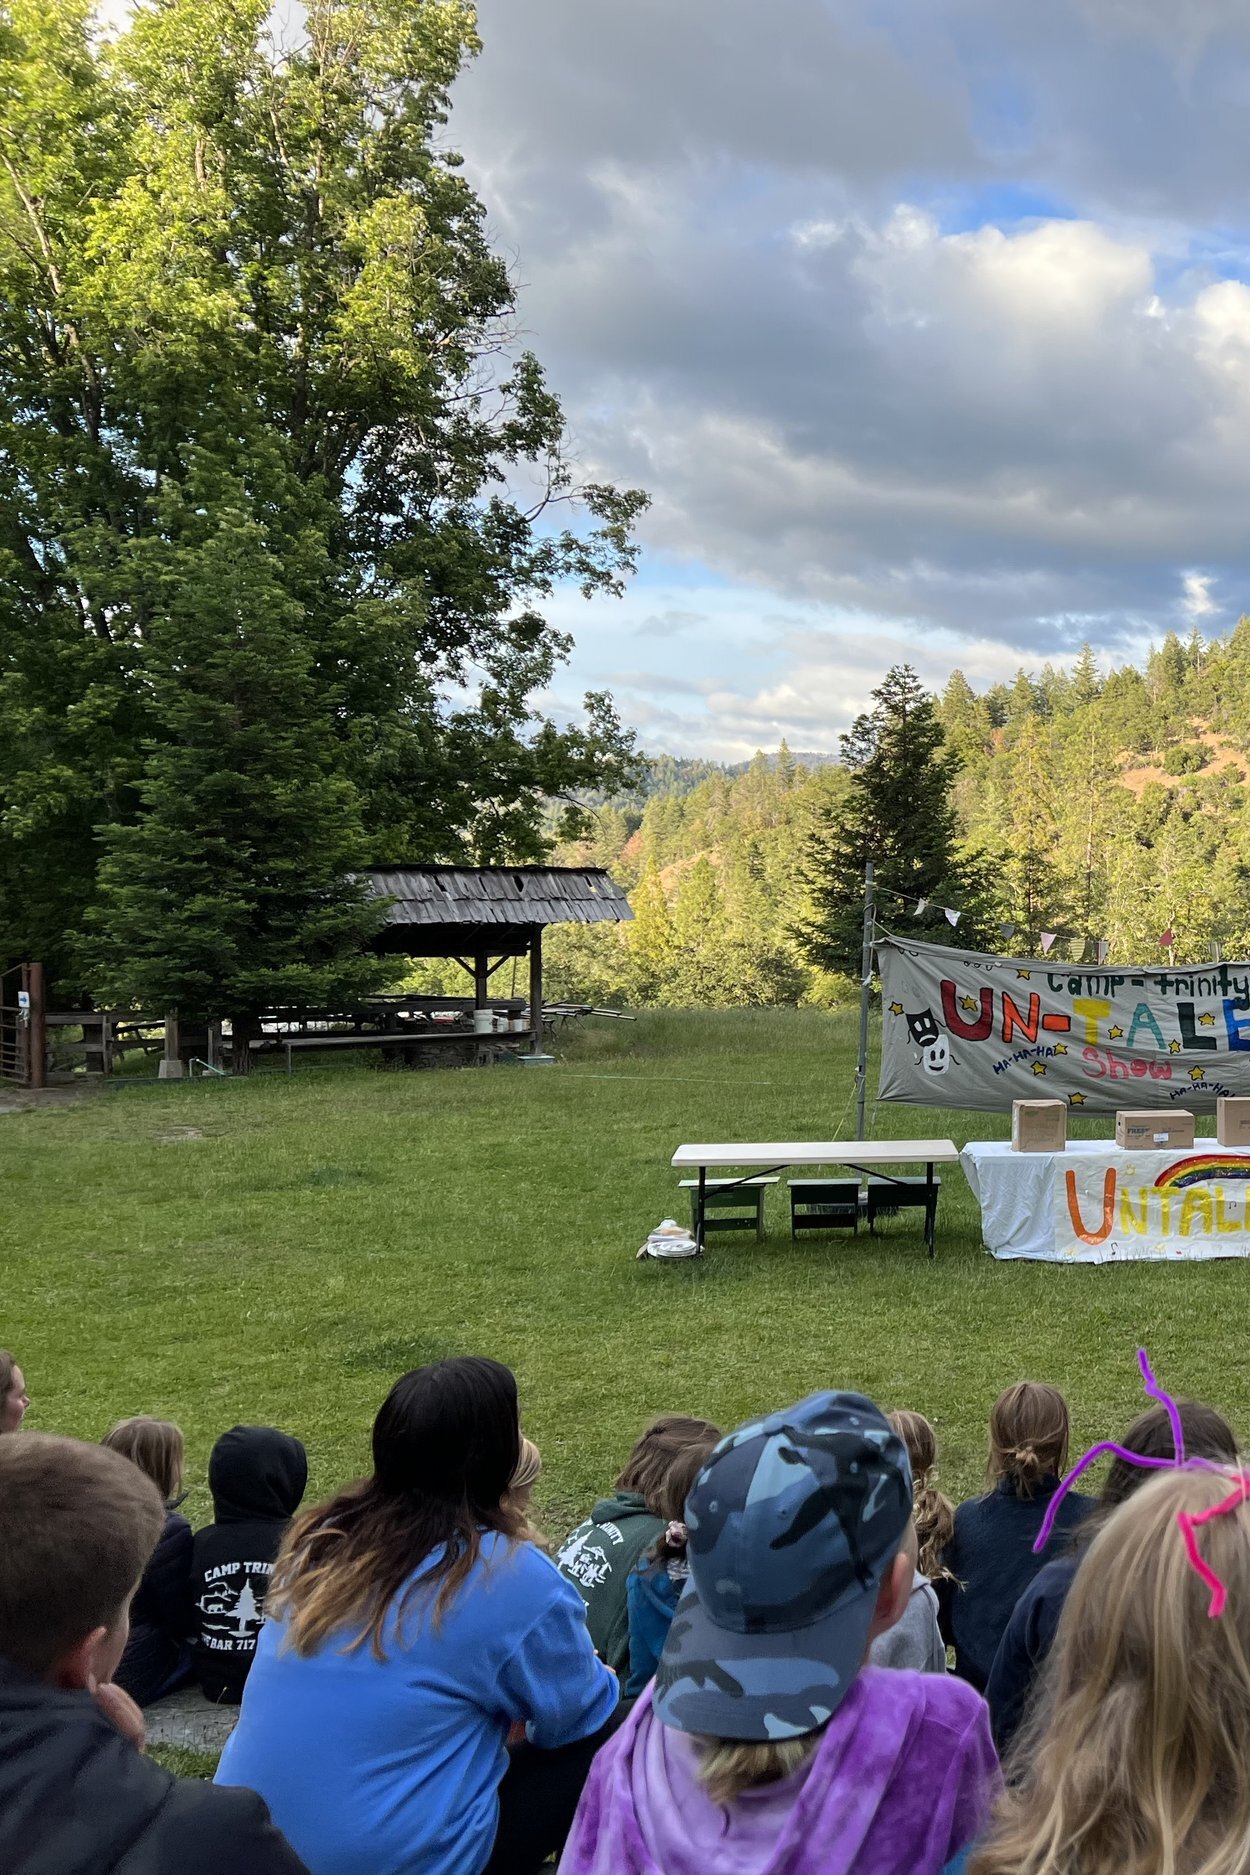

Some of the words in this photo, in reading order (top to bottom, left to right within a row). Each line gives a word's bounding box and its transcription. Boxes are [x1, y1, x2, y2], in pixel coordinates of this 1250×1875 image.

[1082, 1047, 1173, 1080] Show
[204, 1562, 240, 1582] CAMP
[210, 1639, 233, 1651] BAR
[236, 1639, 256, 1651] 717
